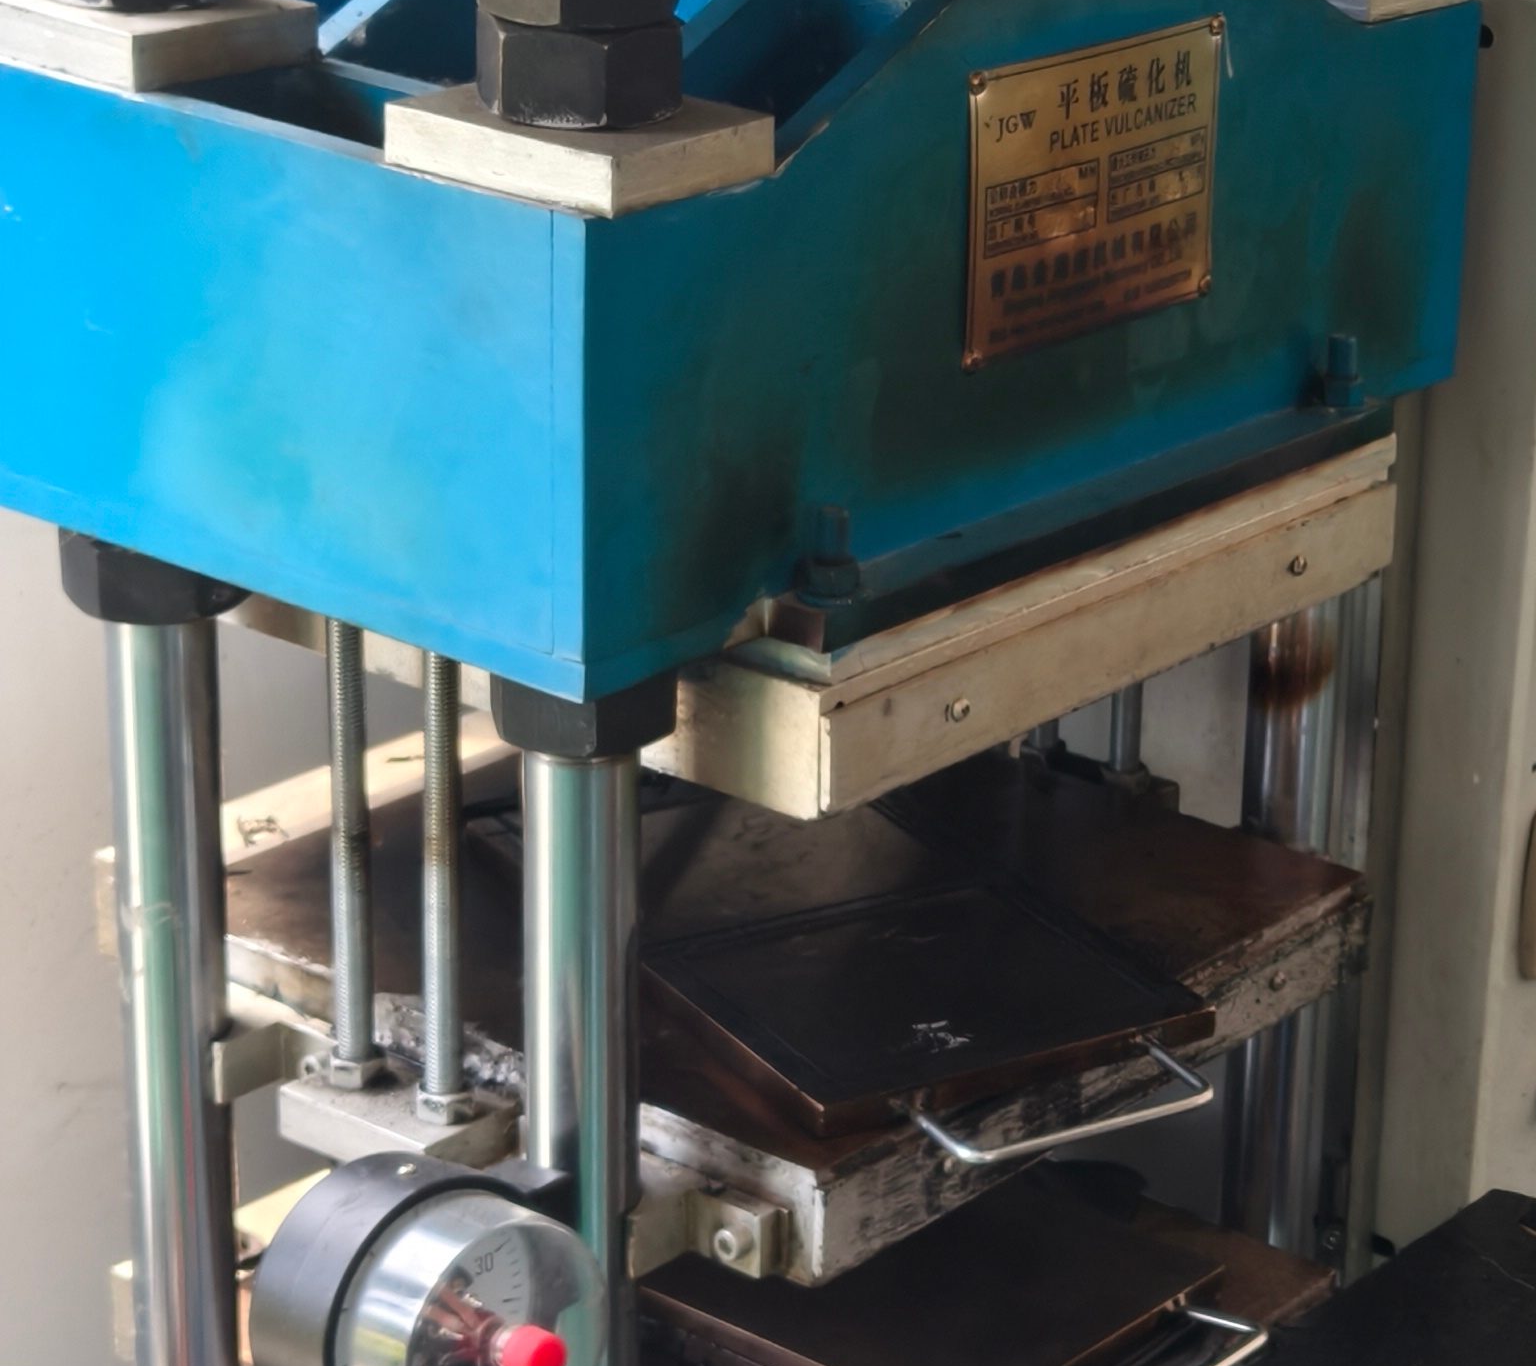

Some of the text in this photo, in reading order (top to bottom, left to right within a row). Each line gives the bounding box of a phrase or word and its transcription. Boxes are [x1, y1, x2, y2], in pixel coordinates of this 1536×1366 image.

[1057, 50, 1192, 120] 平板硫化机
[996, 109, 1037, 143] JGW
[1049, 92, 1197, 153] PLATE VULCANIZER
[473, 1251, 495, 1277] 30
